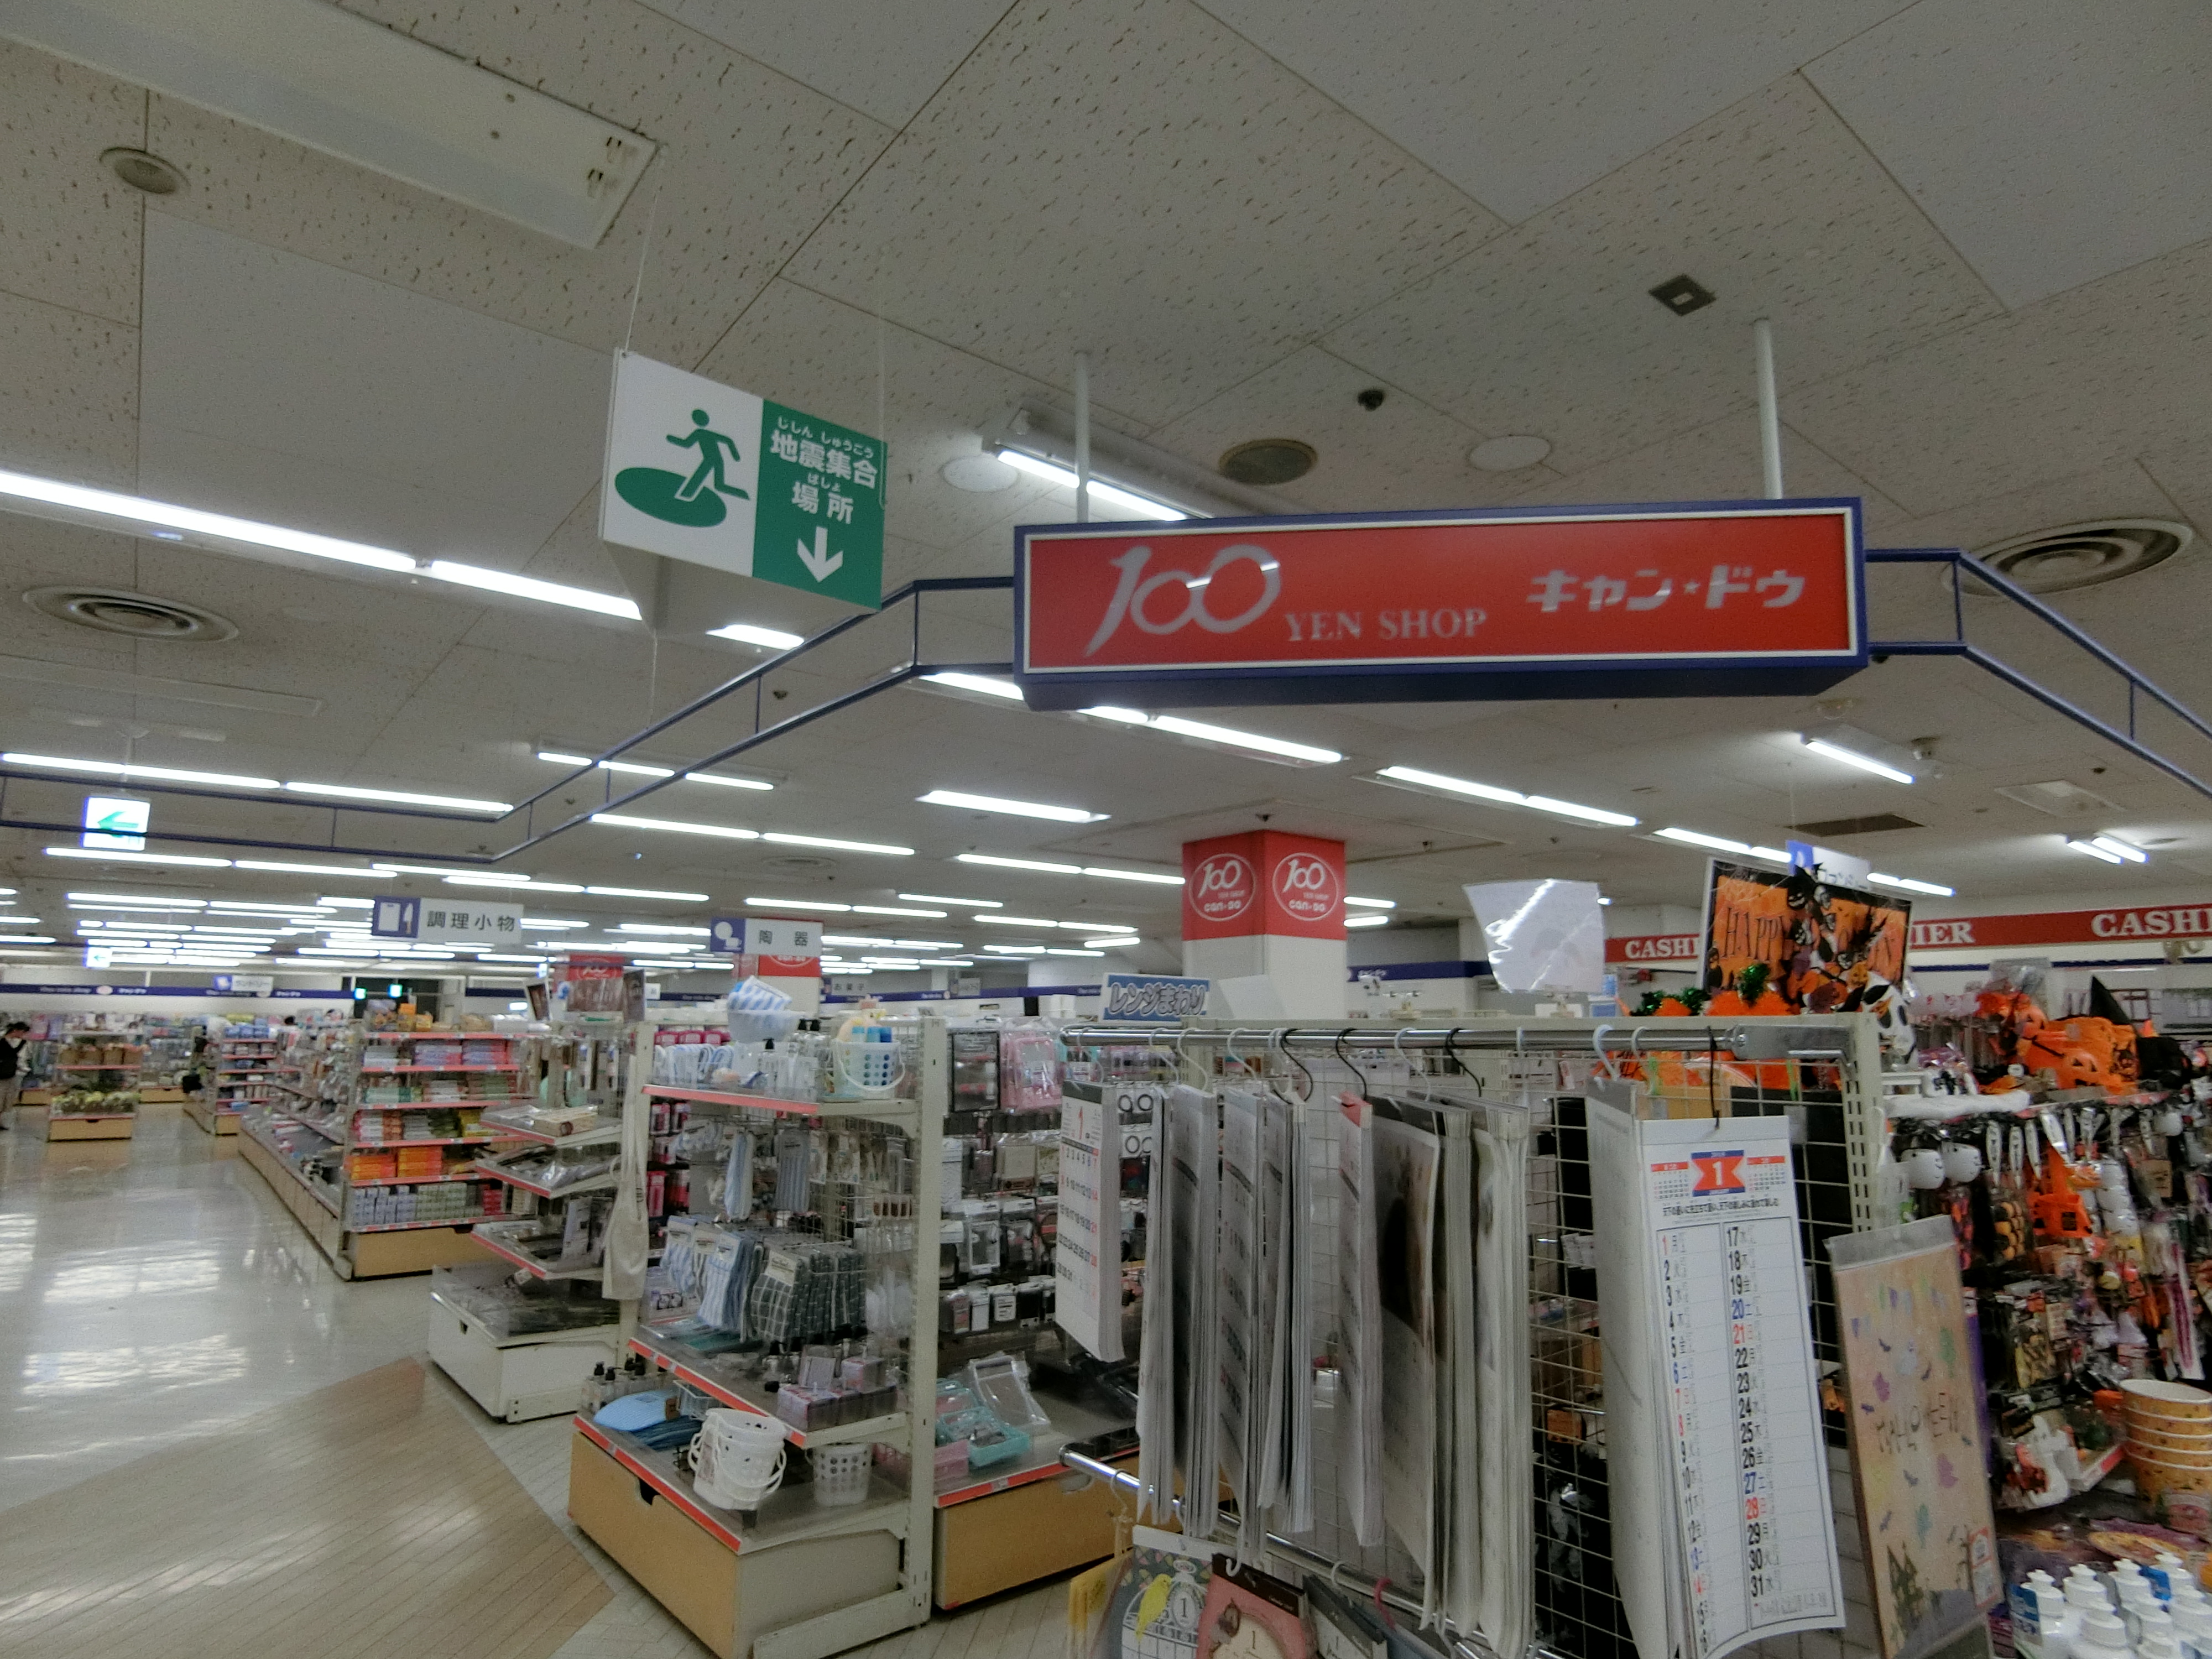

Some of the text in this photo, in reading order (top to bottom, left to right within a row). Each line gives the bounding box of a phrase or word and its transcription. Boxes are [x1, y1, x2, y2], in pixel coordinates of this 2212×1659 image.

[778, 416, 813, 439] じしん
[770, 429, 878, 489] 地震集合
[791, 481, 854, 525] 場所
[1084, 544, 1487, 658] 100 YEN SHOP
[1198, 859, 1242, 899] 100
[1282, 858, 1326, 893] 100
[427, 910, 515, 932] 調理小物
[1910, 921, 1976, 946] IER
